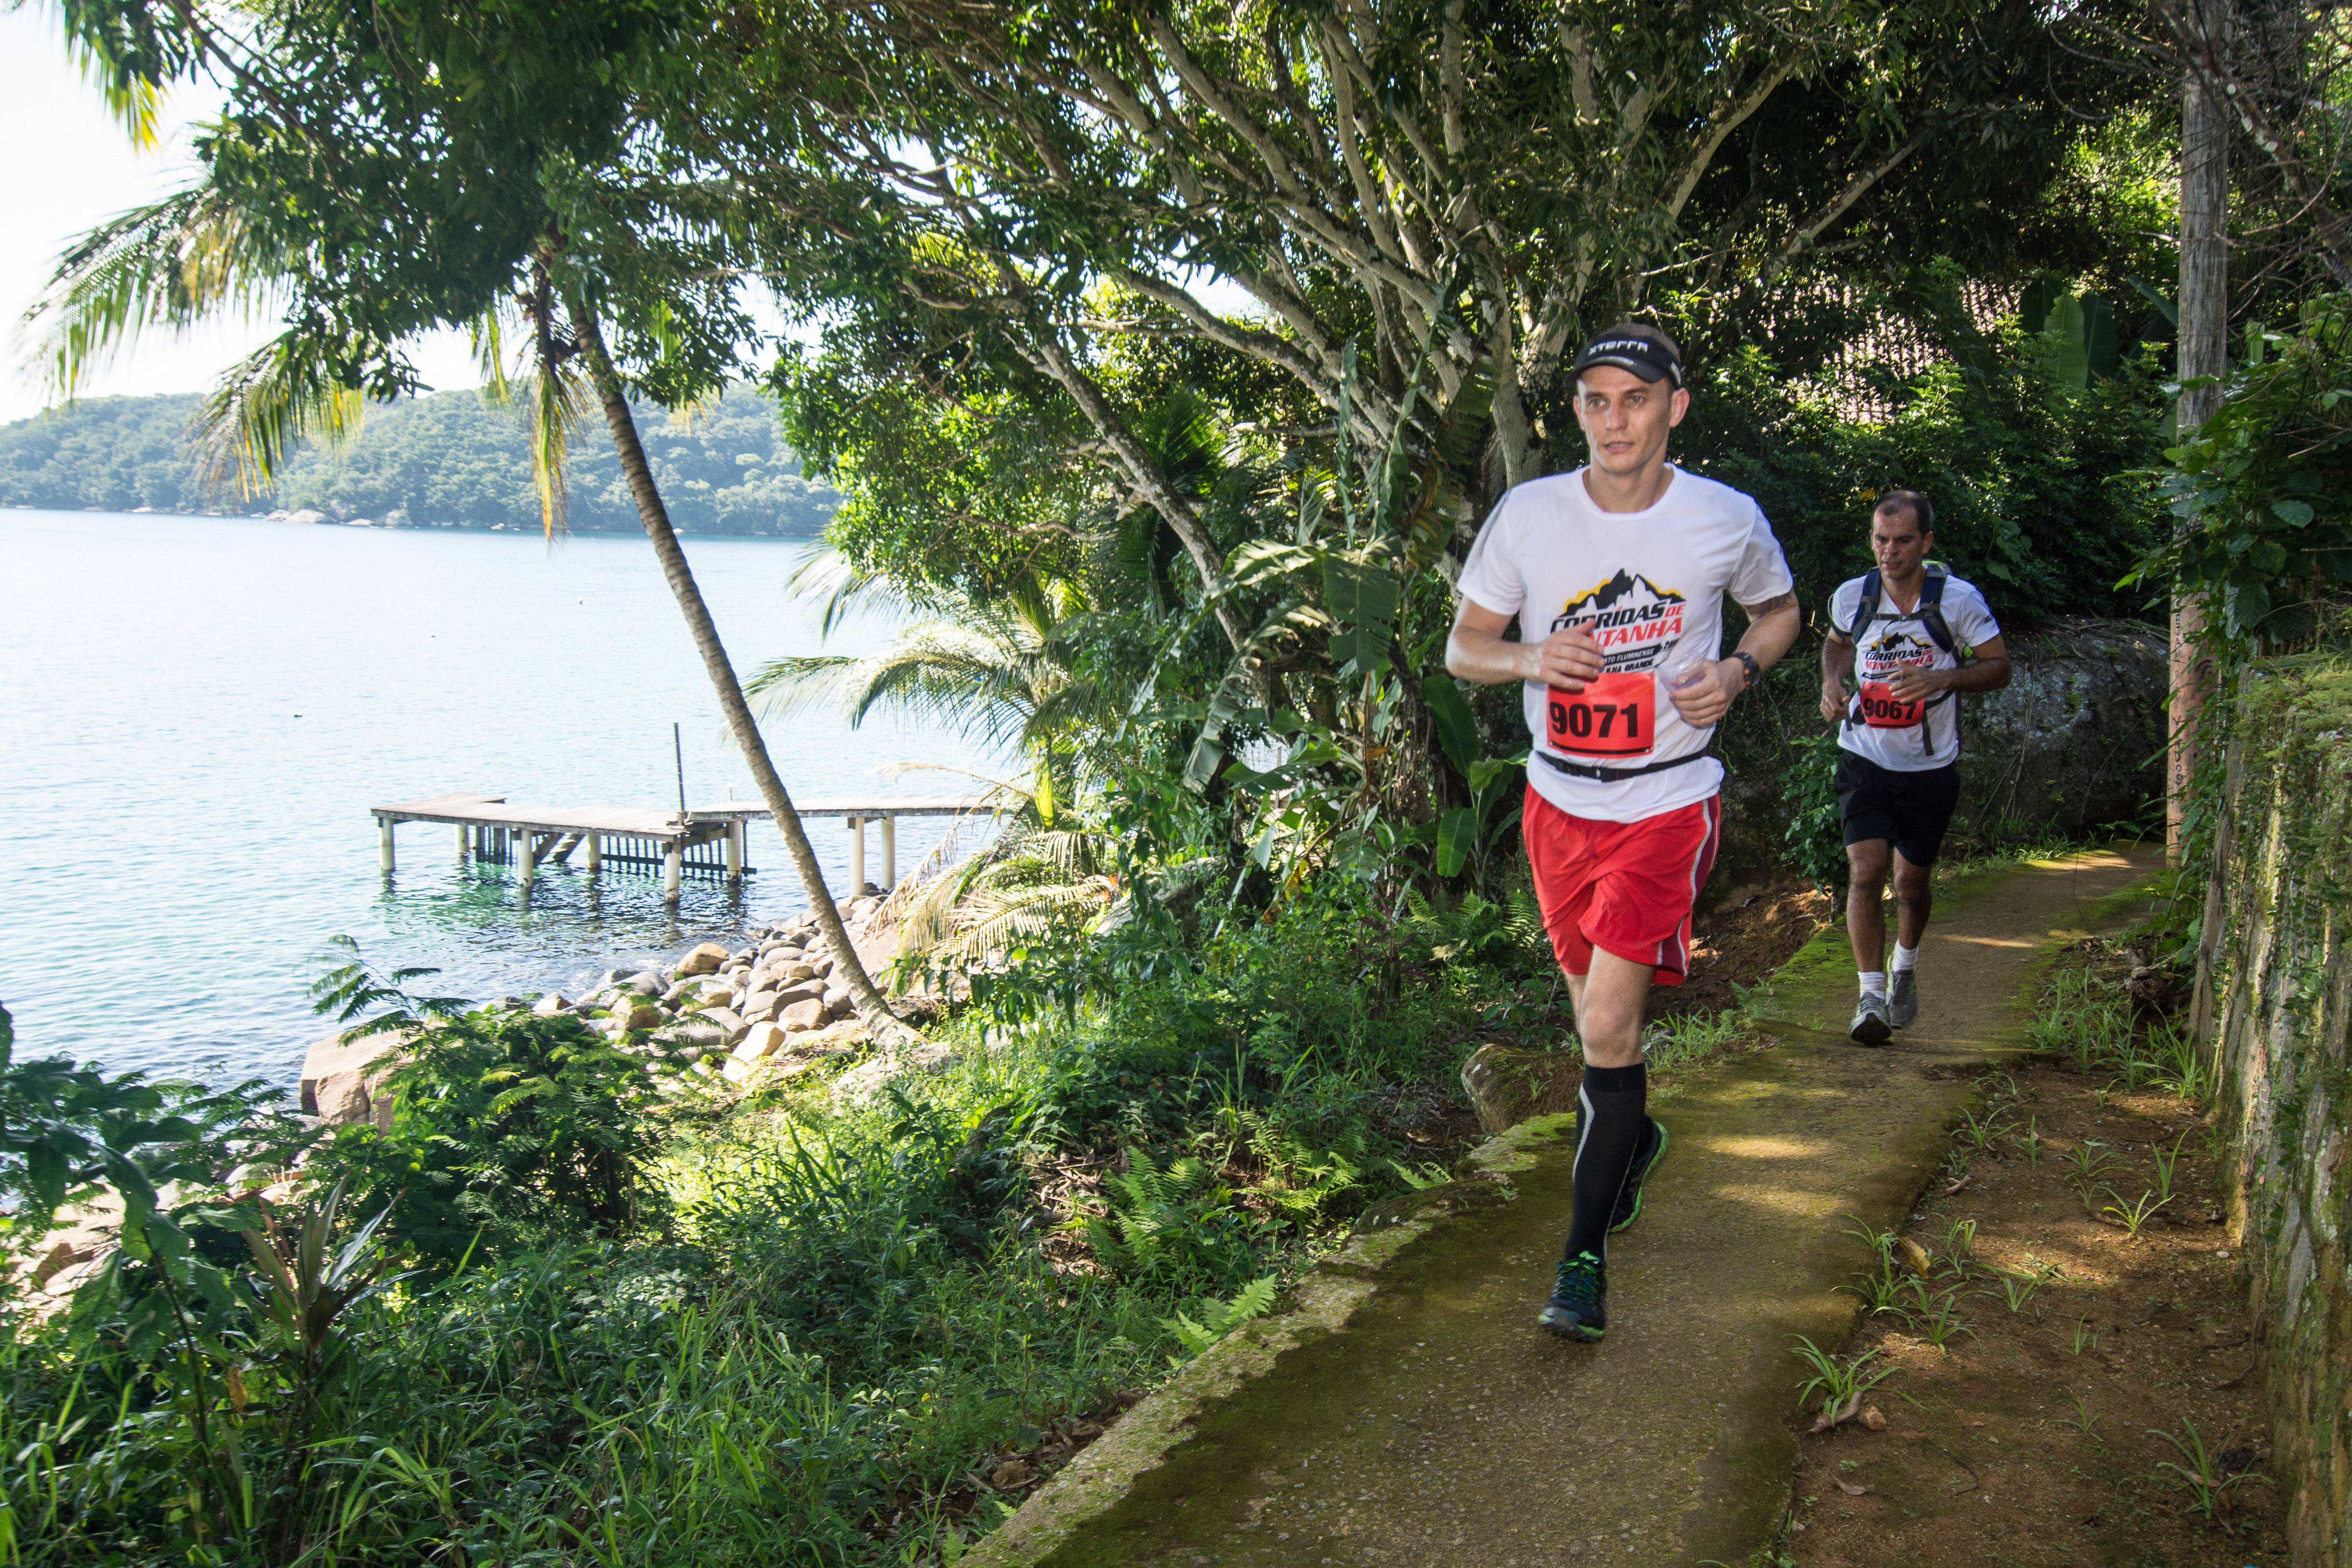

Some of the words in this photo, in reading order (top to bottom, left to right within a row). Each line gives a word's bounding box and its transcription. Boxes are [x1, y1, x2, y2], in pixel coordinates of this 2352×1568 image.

[1665, 603, 1686, 617] DE
[1865, 654, 1933, 670] MONTNHA
[1863, 698, 1917, 720] 9067
[1550, 701, 1638, 737] 9071
